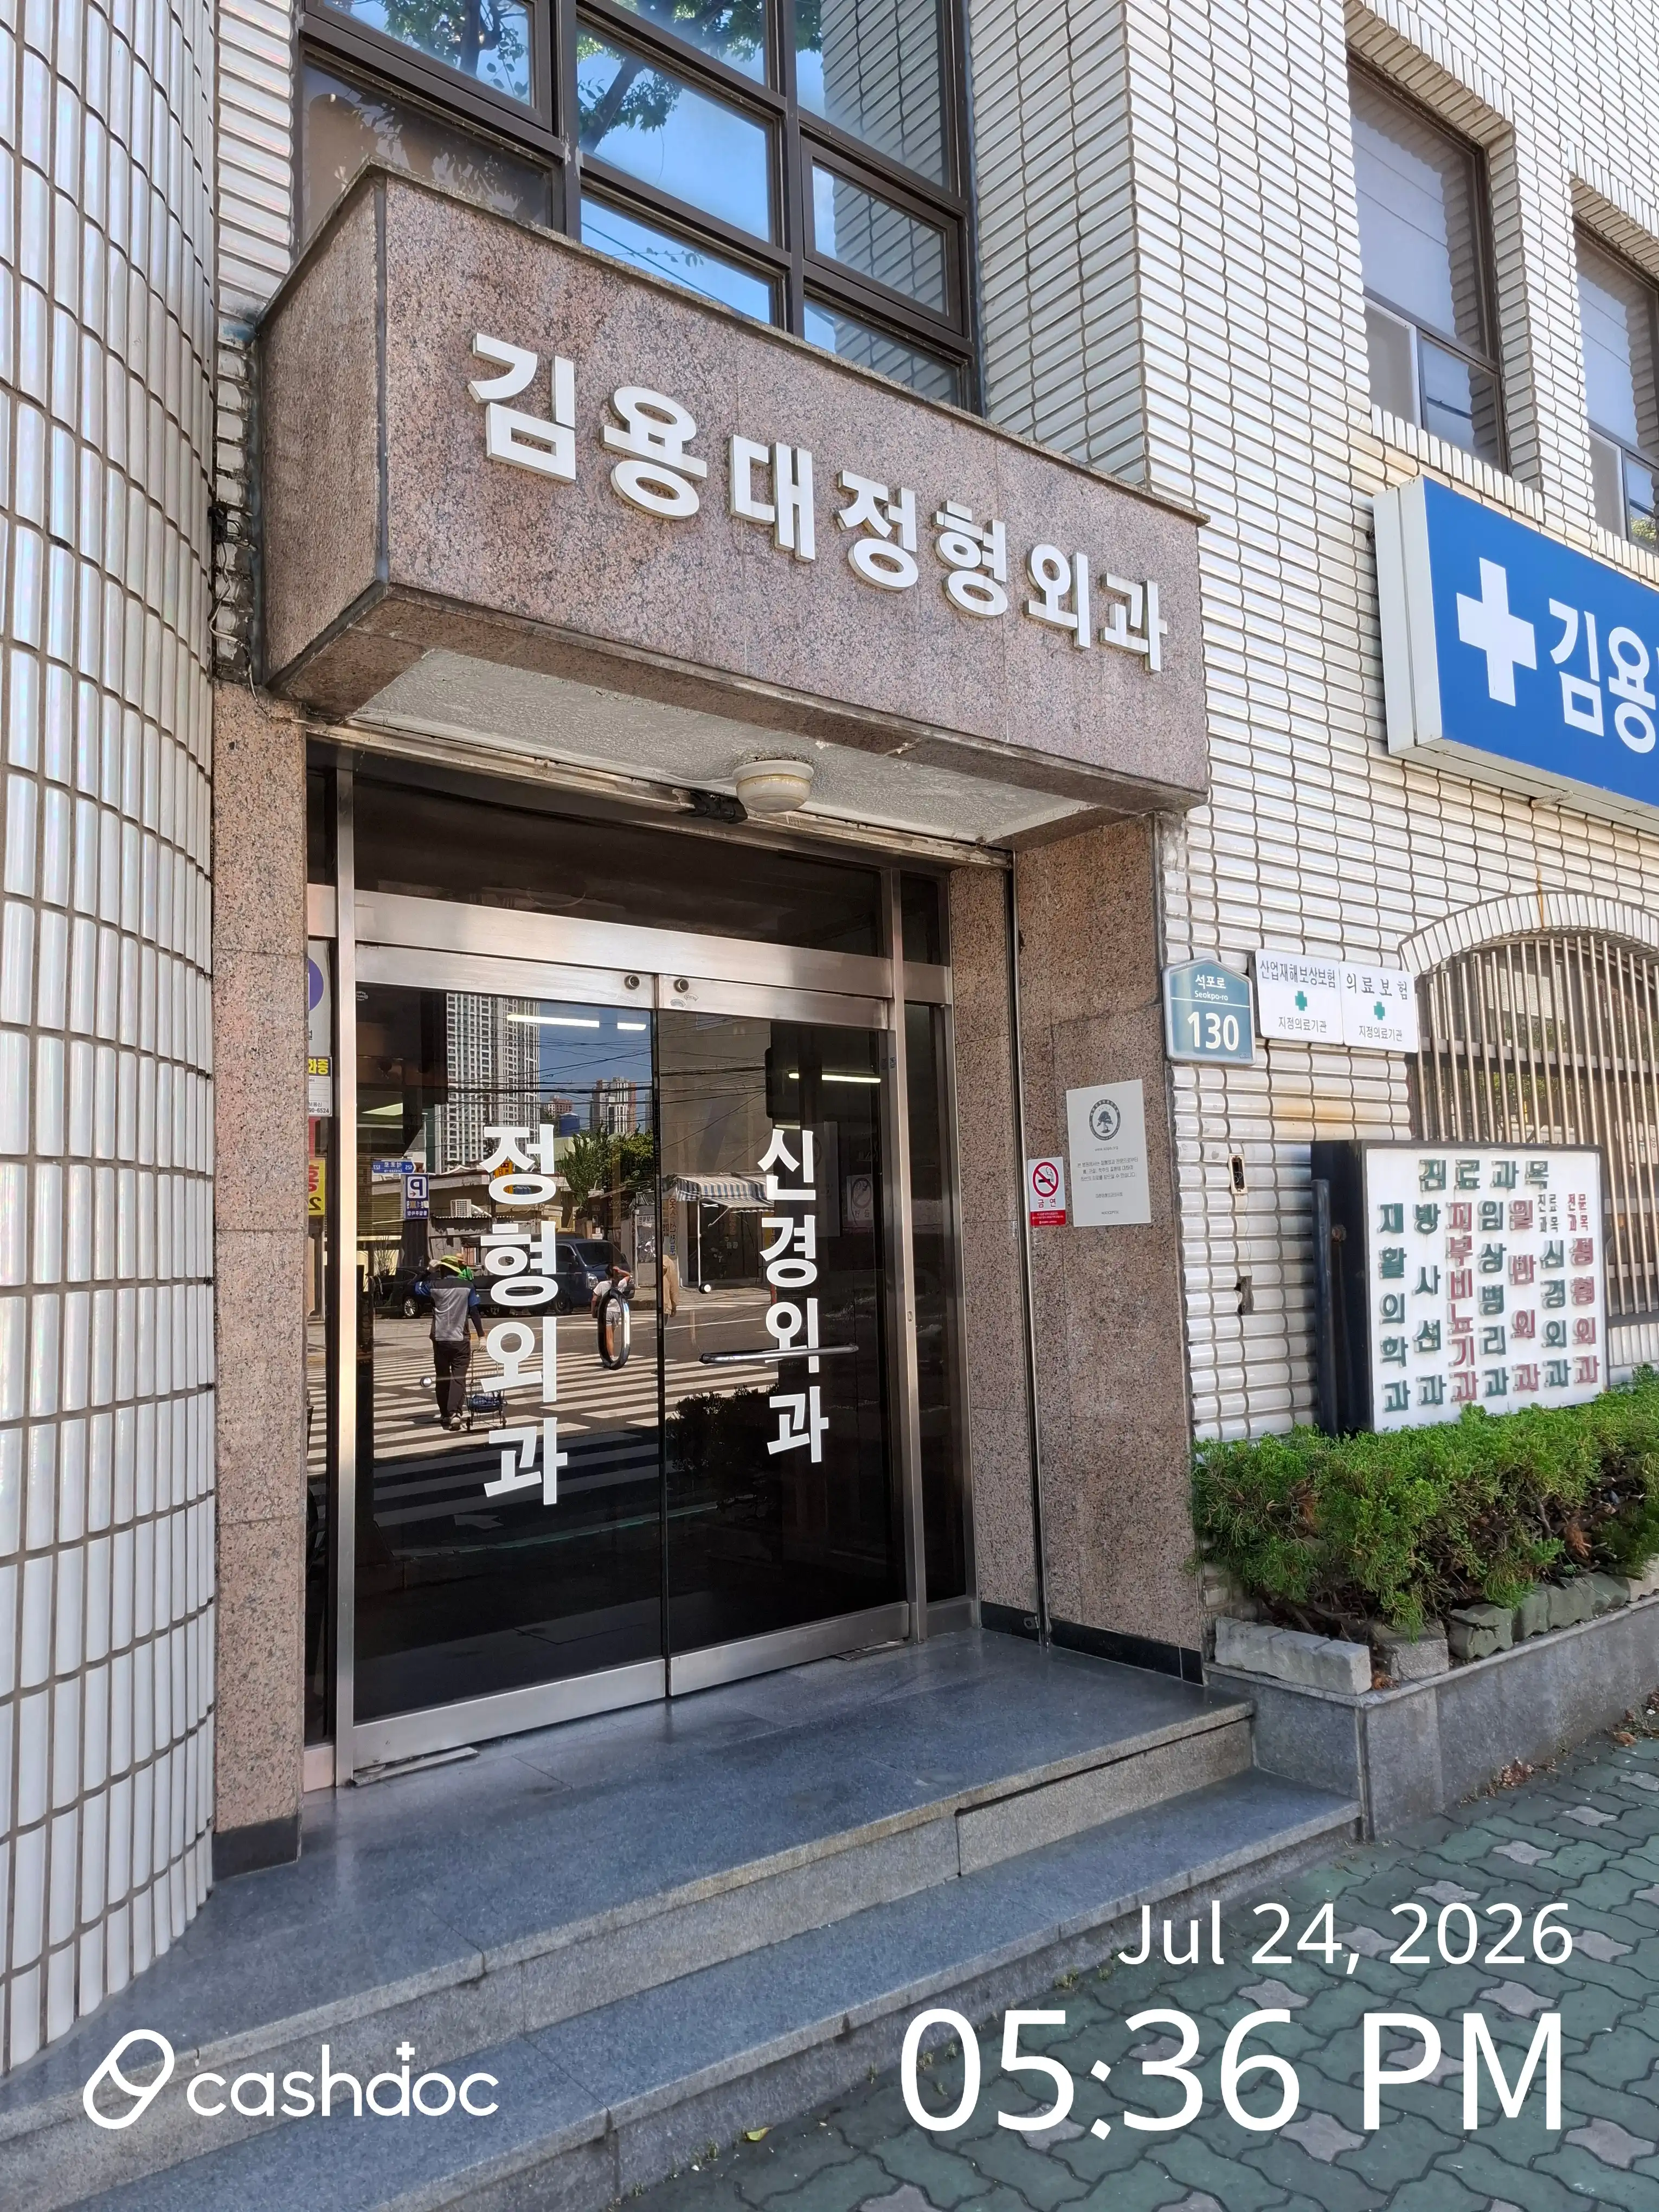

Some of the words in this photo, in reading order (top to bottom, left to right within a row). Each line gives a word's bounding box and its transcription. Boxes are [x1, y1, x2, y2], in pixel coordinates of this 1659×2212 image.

[467, 332, 1169, 673] 김용대정형외과
[1549, 598, 1659, 753] 김용
[1194, 991, 1229, 1000] Seokpo-ro
[1195, 974, 1226, 989] 석포로
[1260, 960, 1335, 988] 산업재해보상보험
[1346, 973, 1407, 1000] 의료보험
[1187, 1012, 1239, 1051] 130
[1278, 1017, 1327, 1033] 지정의료기관
[1359, 1026, 1403, 1041] 지정의료기관
[1038, 1198, 1056, 1208] 금연
[1419, 1159, 1549, 1191] 진료과목
[1538, 1194, 1557, 1213] 진료
[1539, 1216, 1558, 1233] 과목
[480, 1124, 568, 1505] 정형외과
[758, 1125, 828, 1463] 신경외과
[1377, 1203, 1411, 1412] 재활의학과
[1412, 1203, 1446, 1405] 방사선과
[1445, 1202, 1478, 1402] 피부비뇨기과
[1477, 1200, 1509, 1398] 임상병리과
[1508, 1200, 1541, 1391] 일반외과
[1540, 1240, 1572, 1387] 신경외과
[1569, 1238, 1600, 1383] 정형외과
